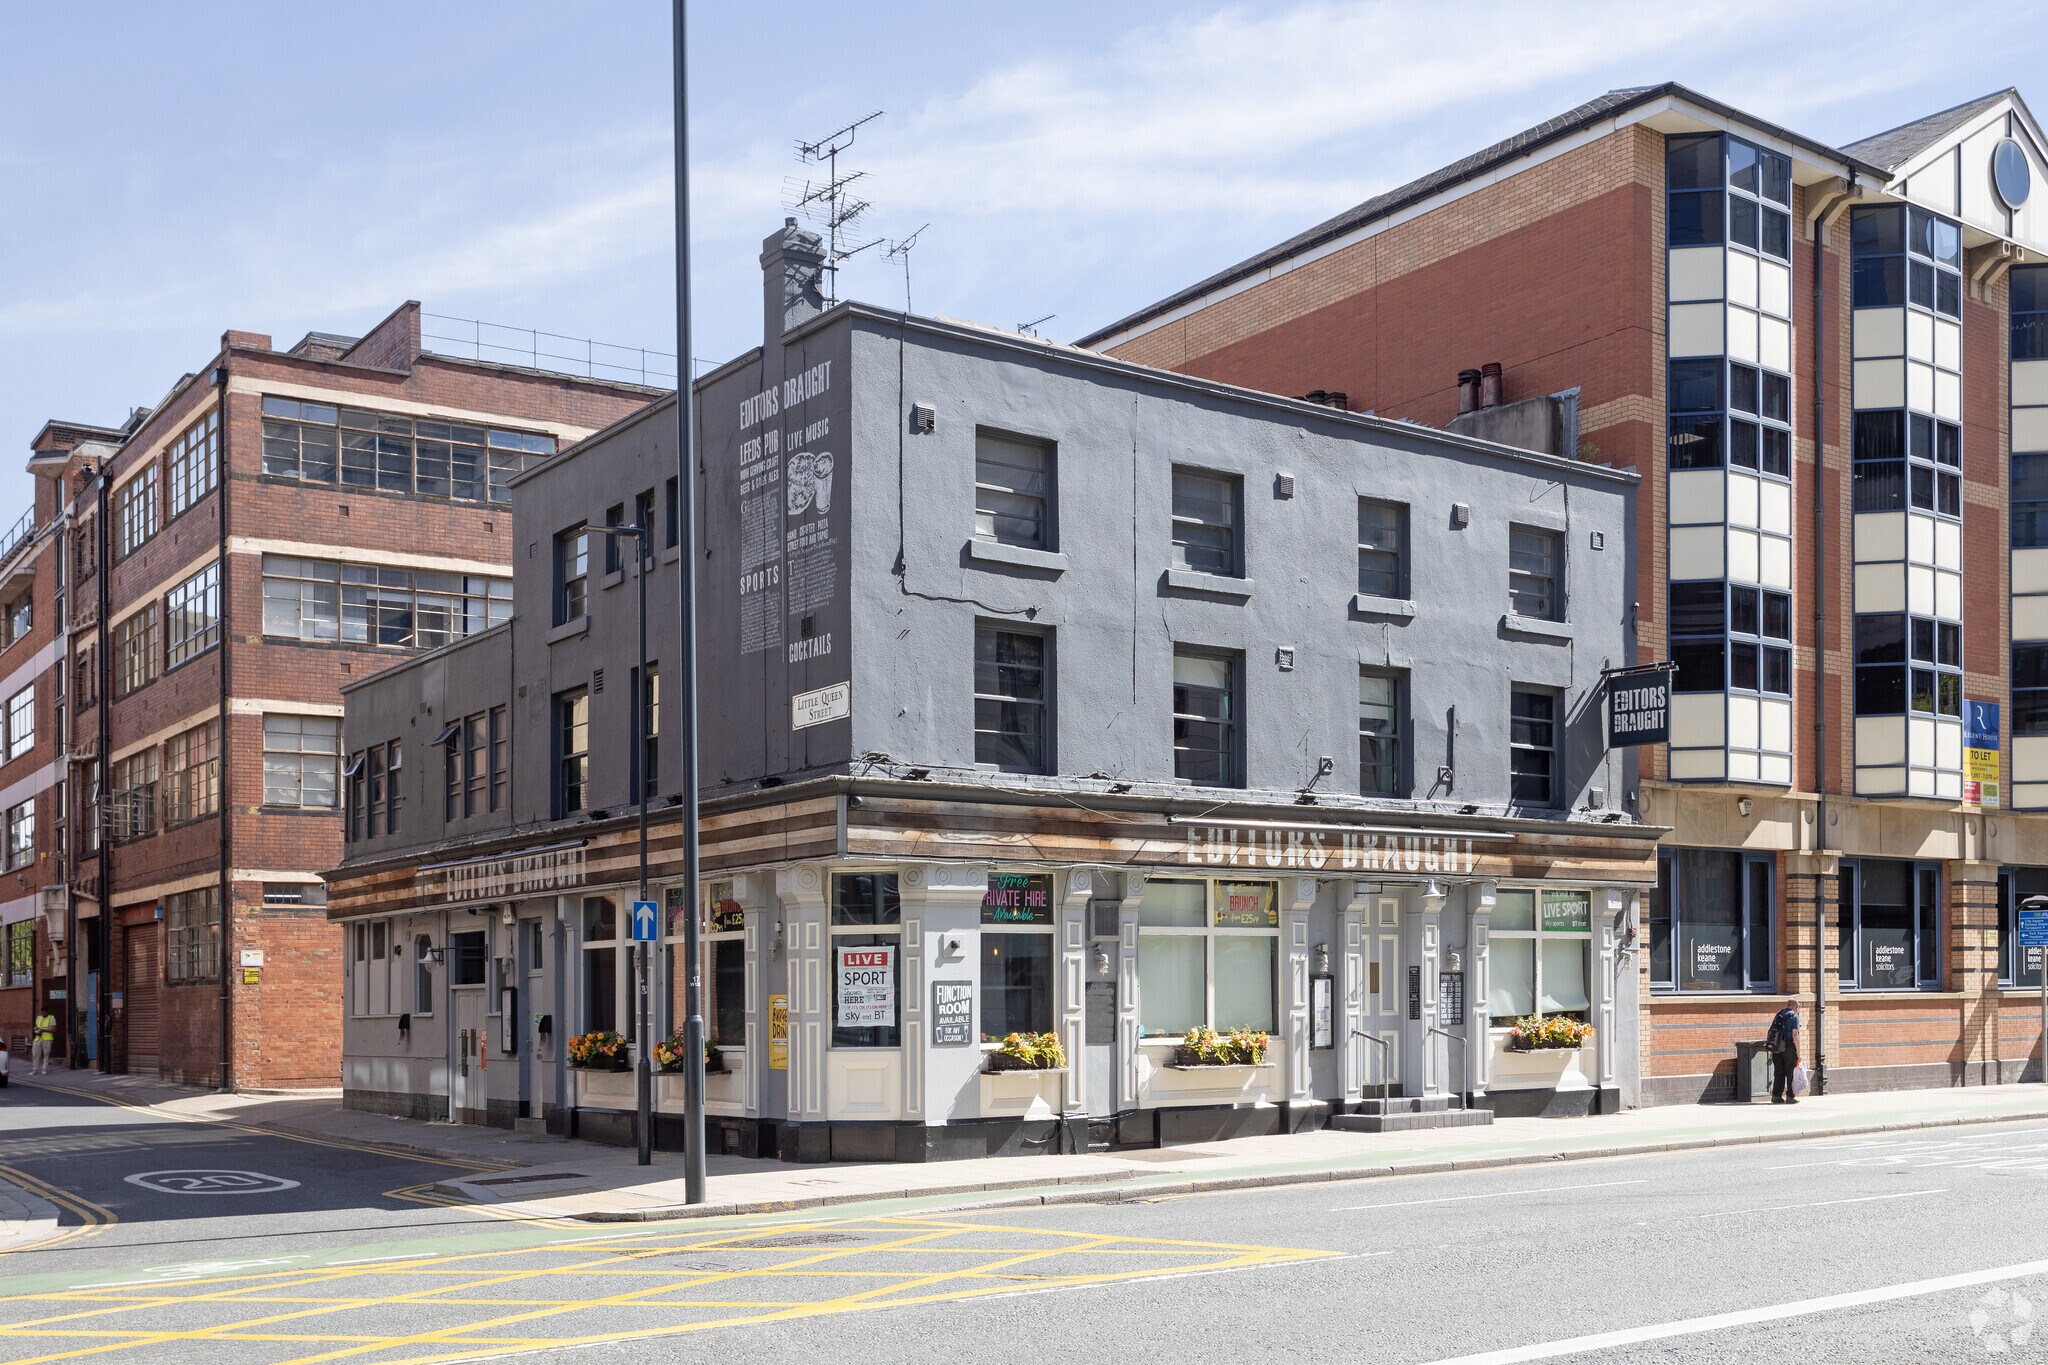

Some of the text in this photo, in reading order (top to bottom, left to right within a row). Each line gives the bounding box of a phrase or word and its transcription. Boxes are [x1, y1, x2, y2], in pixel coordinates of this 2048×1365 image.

[740, 360, 831, 430] EDITORS DRAUGHT
[788, 418, 828, 452] LIVE MUSIC
[740, 430, 778, 466] LEEDS PUB
[740, 482, 750, 495] BEER
[740, 564, 778, 595] SPORTS
[789, 632, 832, 663] COCKTAILS
[798, 690, 842, 710] LITTLE QUEEN
[1614, 686, 1666, 712] EDITORS
[809, 706, 832, 720] STREET
[1614, 710, 1666, 732] DRAUGHT
[1970, 750, 1992, 760] TO LET
[1187, 826, 1473, 873] EDITORS DRAUGHT
[446, 850, 586, 901] EDITORS DRAUGHT
[997, 873, 1030, 889] Free
[1025, 890, 1046, 906] HIRE
[1230, 896, 1258, 912] BRUNCH
[993, 907, 1034, 921] Available
[1544, 900, 1588, 918] LIVE SPORT
[1698, 944, 1731, 953] addlestone
[1876, 946, 1904, 954] addlestone
[848, 954, 882, 965] LIVE
[1698, 953, 1716, 962] keane
[1876, 954, 1892, 962] keane
[1698, 962, 1720, 971] solicitors
[844, 972, 886, 985] SPORT
[844, 996, 864, 1004] HERE
[937, 985, 972, 1004] FUNCTION
[939, 1000, 970, 1014] ROOM
[845, 1011, 860, 1021] sky
[874, 1011, 885, 1019] BT
[940, 1015, 970, 1024] AVAILABLE
[772, 1023, 787, 1038] DRIN
[159, 1175, 263, 1190] 20
